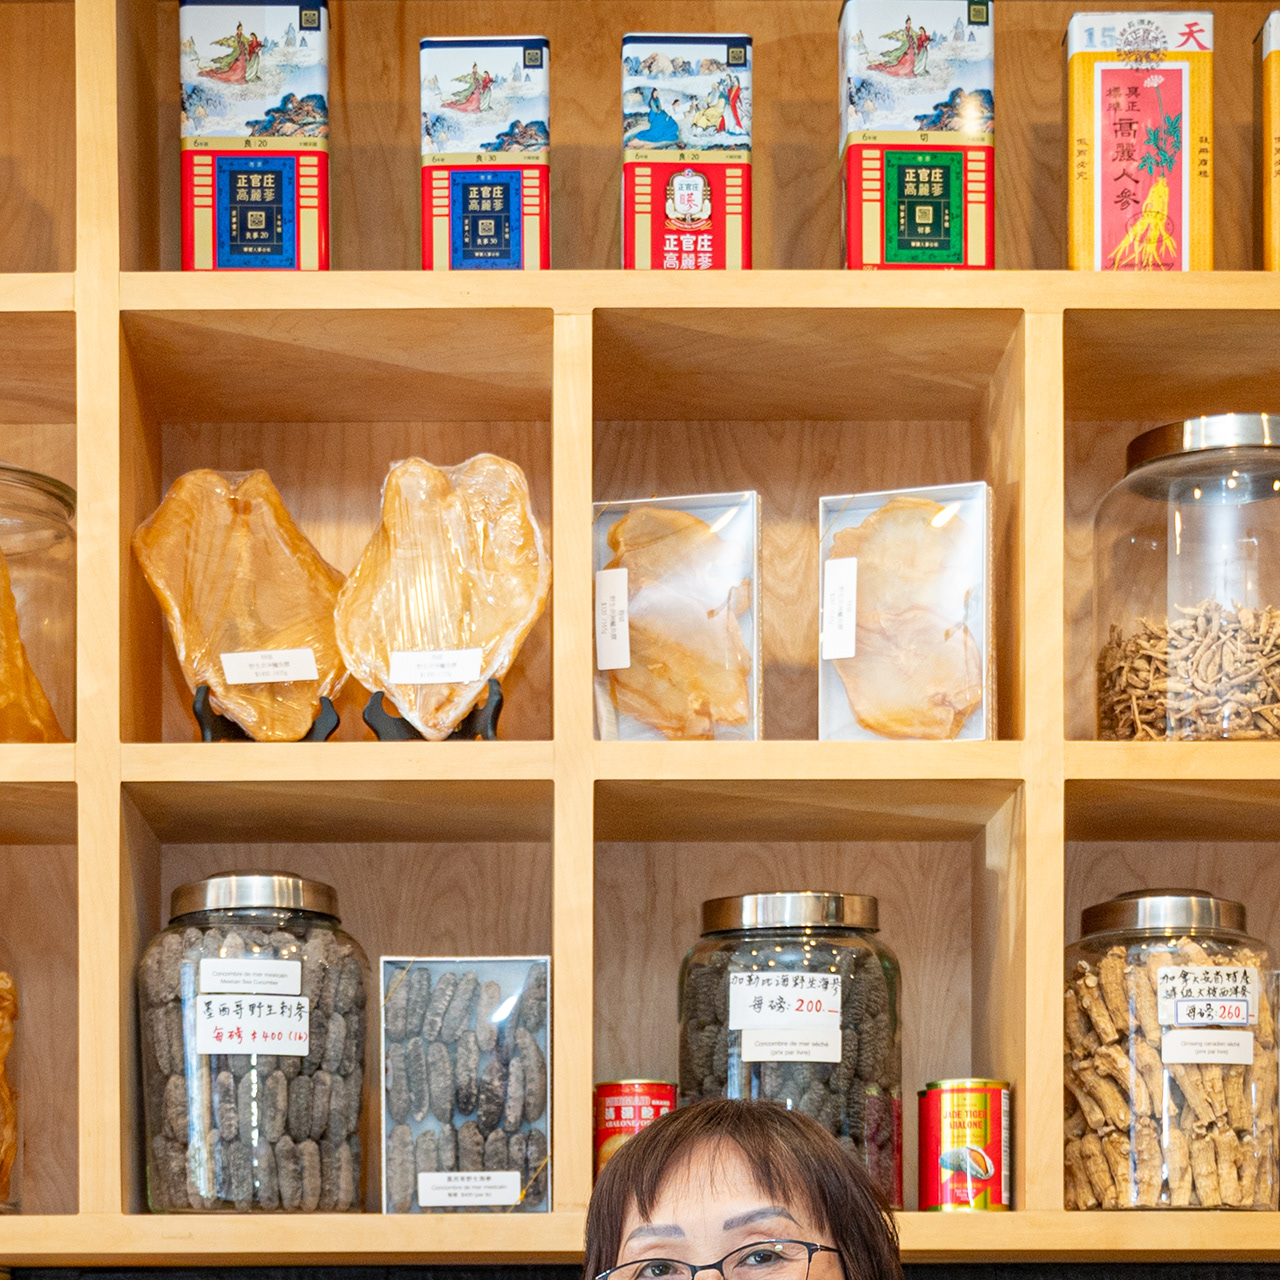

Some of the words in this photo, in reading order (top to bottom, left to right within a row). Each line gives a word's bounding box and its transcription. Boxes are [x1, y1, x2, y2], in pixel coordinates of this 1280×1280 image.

[1083, 27, 1117, 48] 15
[1175, 21, 1210, 50] 天
[236, 175, 275, 187] 正官庄
[904, 168, 943, 182] 正官庄
[469, 187, 504, 198] 正官庄
[664, 234, 712, 251] 正官庄
